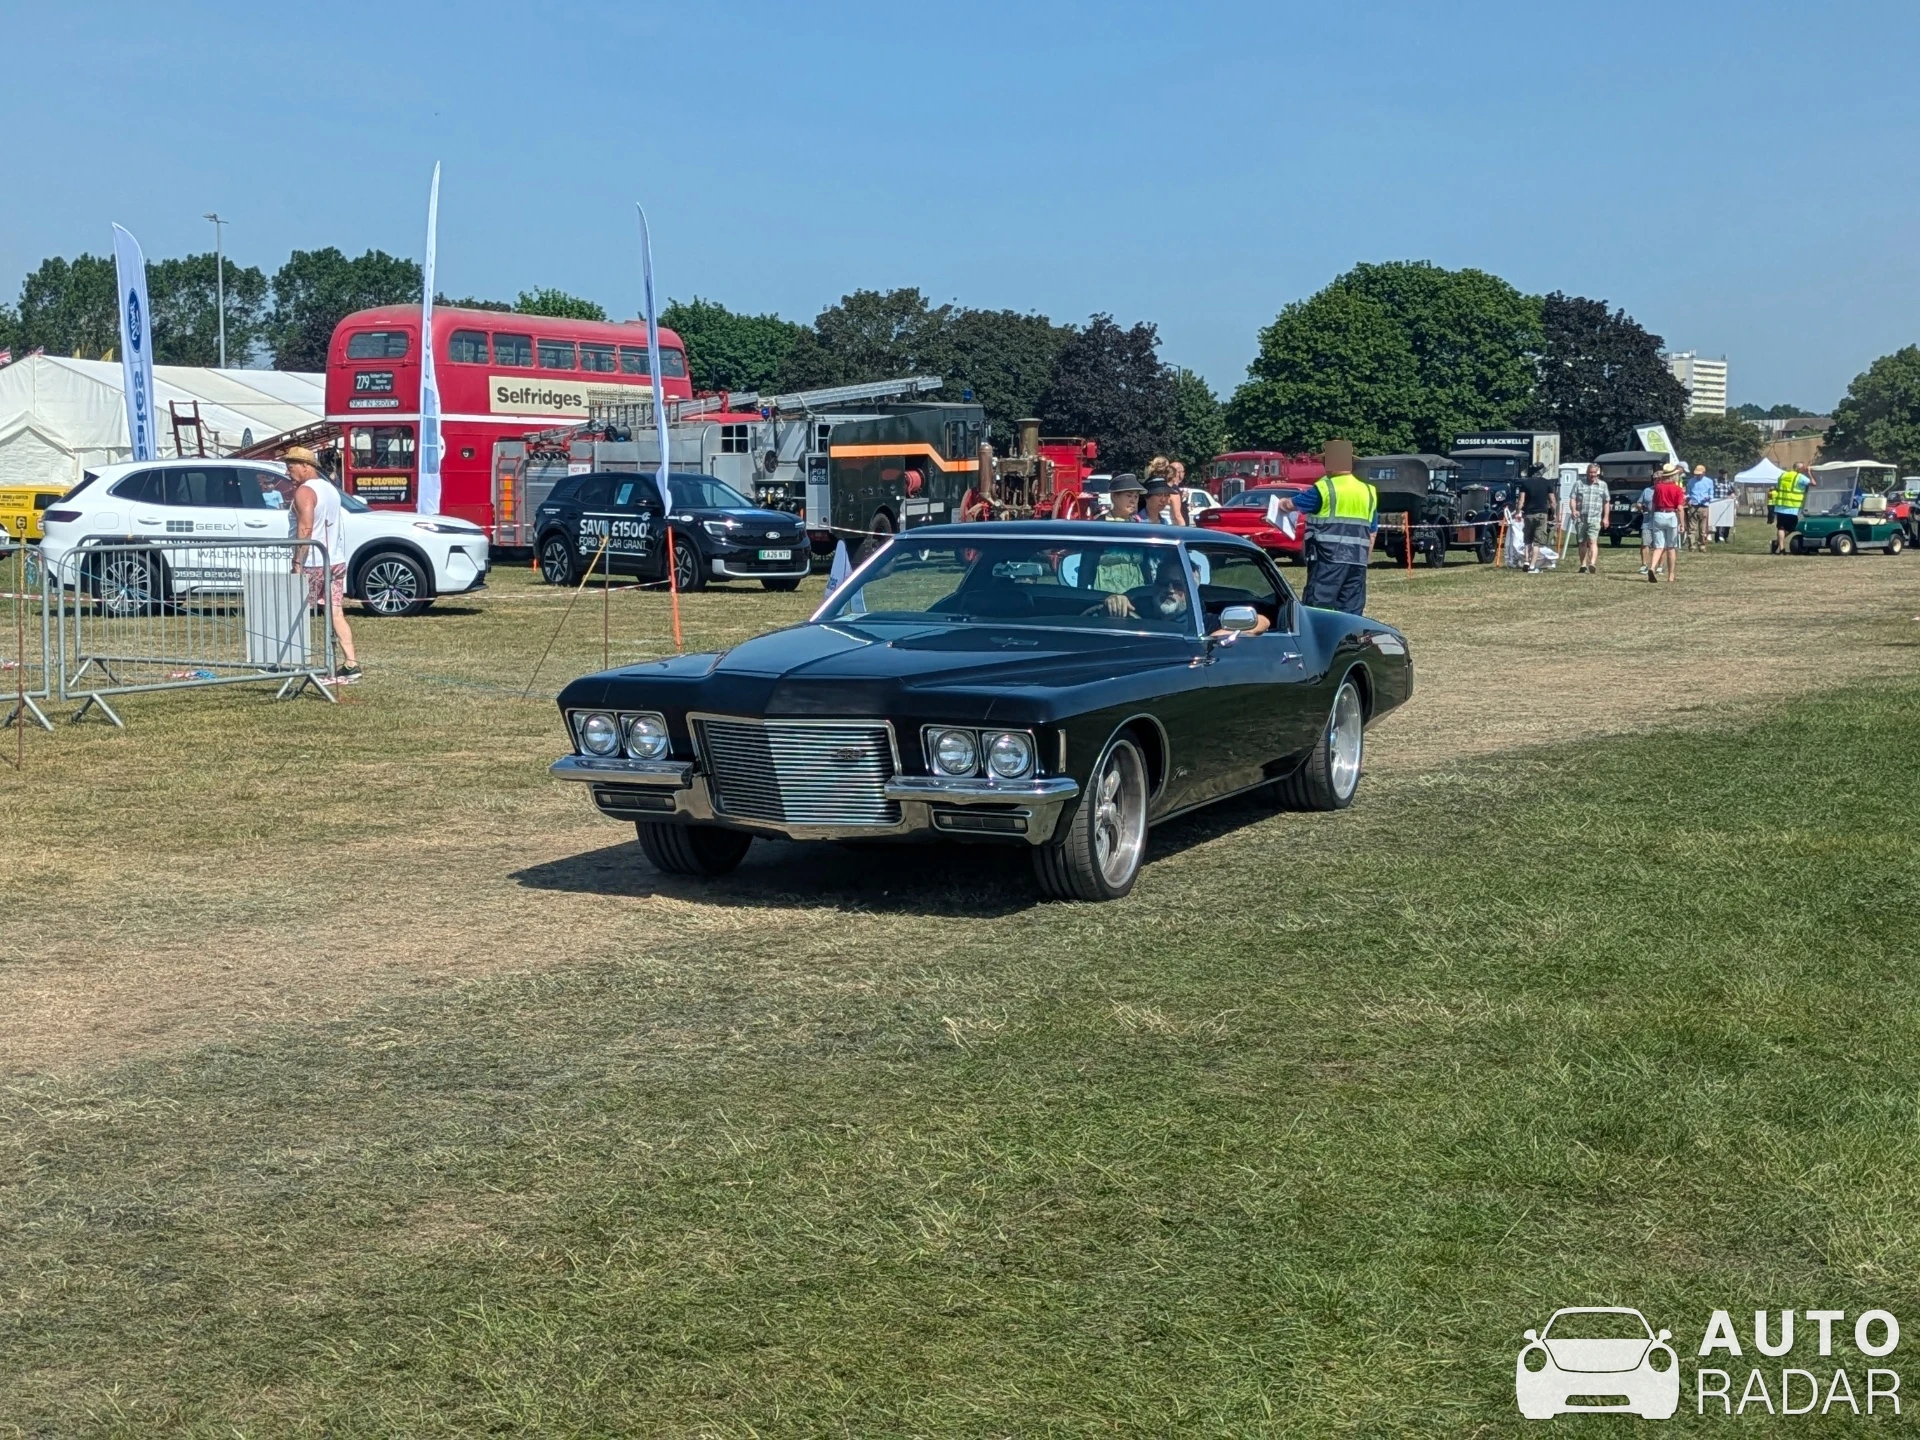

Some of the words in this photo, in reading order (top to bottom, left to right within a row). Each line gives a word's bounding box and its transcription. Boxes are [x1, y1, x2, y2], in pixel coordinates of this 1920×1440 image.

[356, 374, 370, 390] 279
[496, 386, 582, 410] Selfridges
[356, 477, 372, 486] GET
[372, 477, 408, 486] GLOWING
[195, 523, 237, 531] GEELY
[579, 536, 598, 547] FORD
[622, 539, 647, 550] GRANT
[197, 550, 256, 560] WALTHAM
